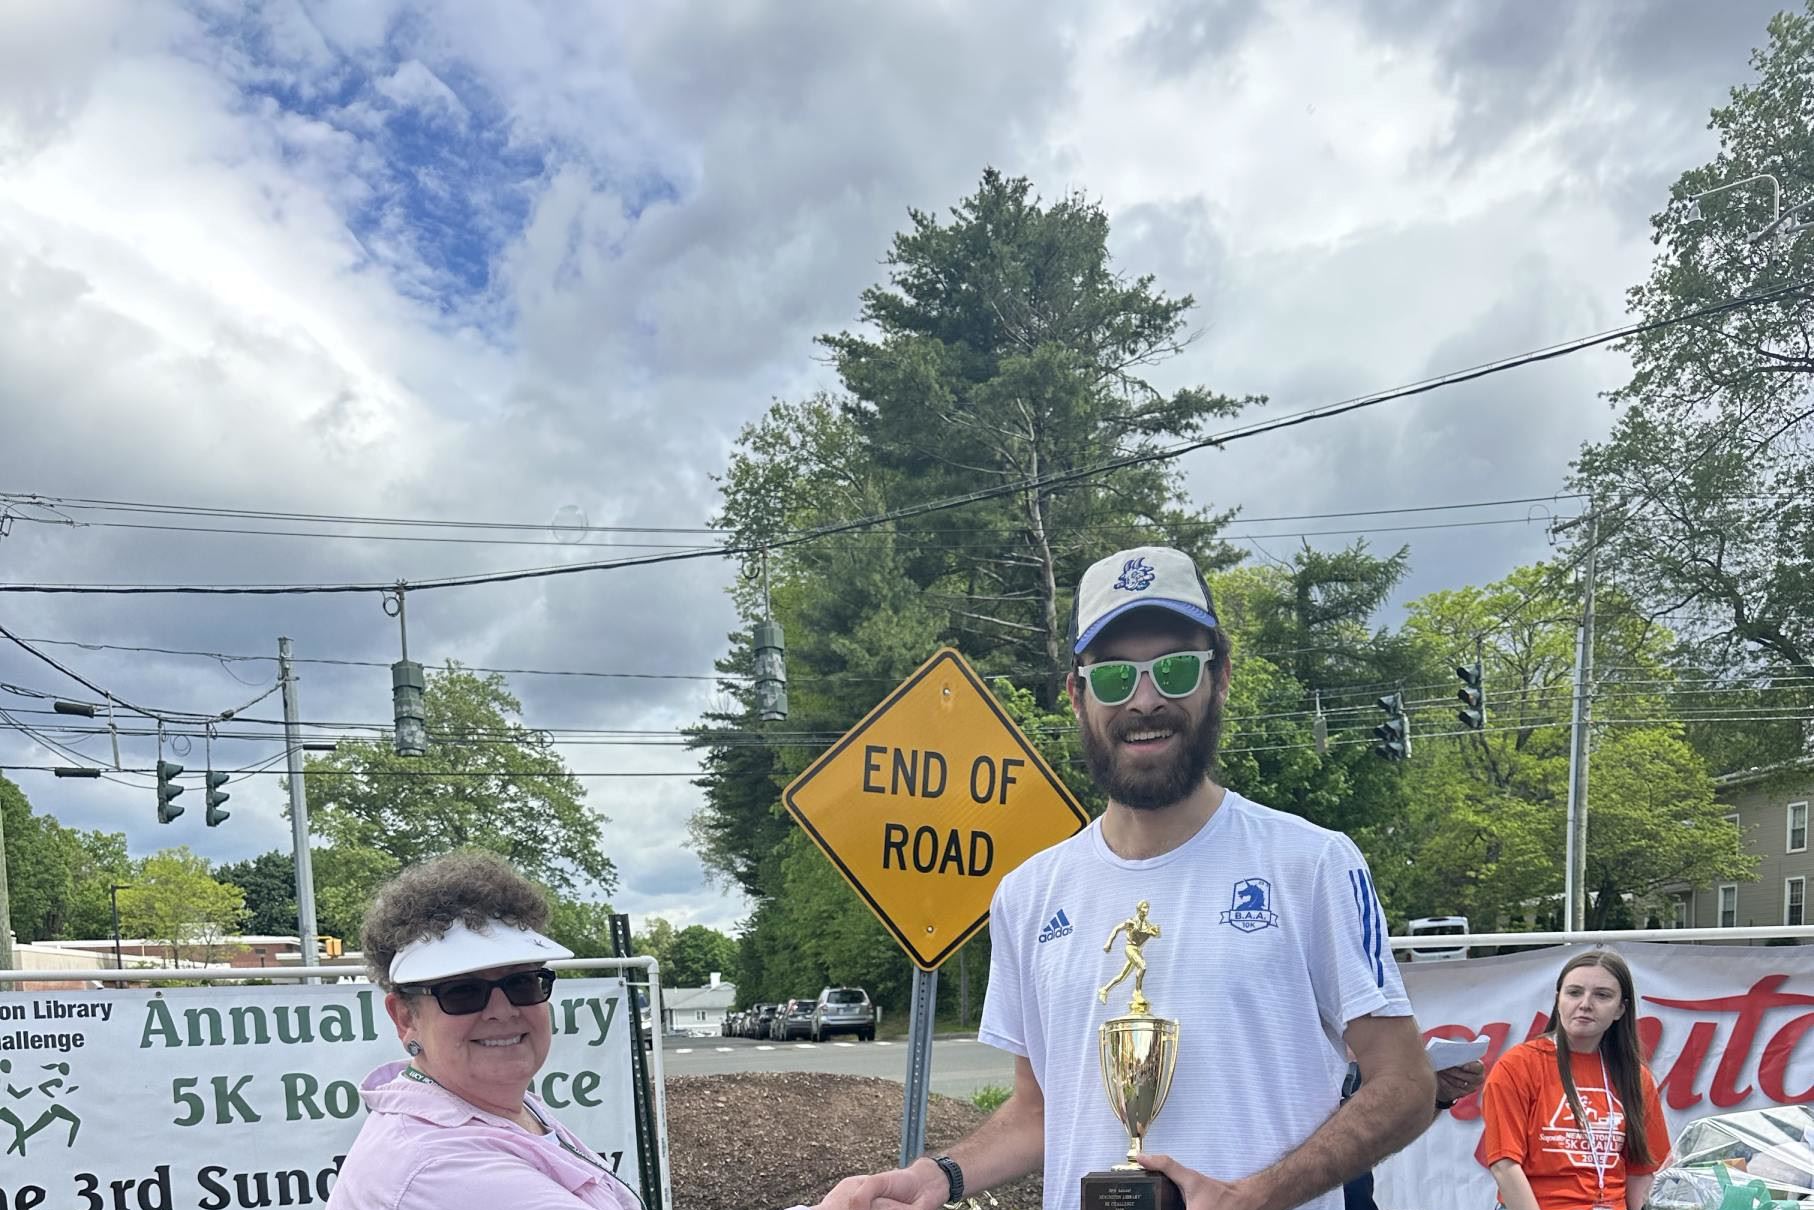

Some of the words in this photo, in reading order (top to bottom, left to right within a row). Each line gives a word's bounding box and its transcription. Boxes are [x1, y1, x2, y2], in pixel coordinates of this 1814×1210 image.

[863, 745, 948, 799] END
[970, 755, 1025, 805] OF
[882, 822, 995, 877] ROAD
[1038, 925, 1074, 944] adidas
[1234, 911, 1266, 920] B.A.A.
[33, 1000, 113, 1021] Library
[139, 990, 379, 1049] Annual
[0, 1031, 86, 1053] allenge
[172, 1074, 262, 1127] 5K
[280, 1072, 373, 1121] Ro
[527, 1070, 604, 1109] ce
